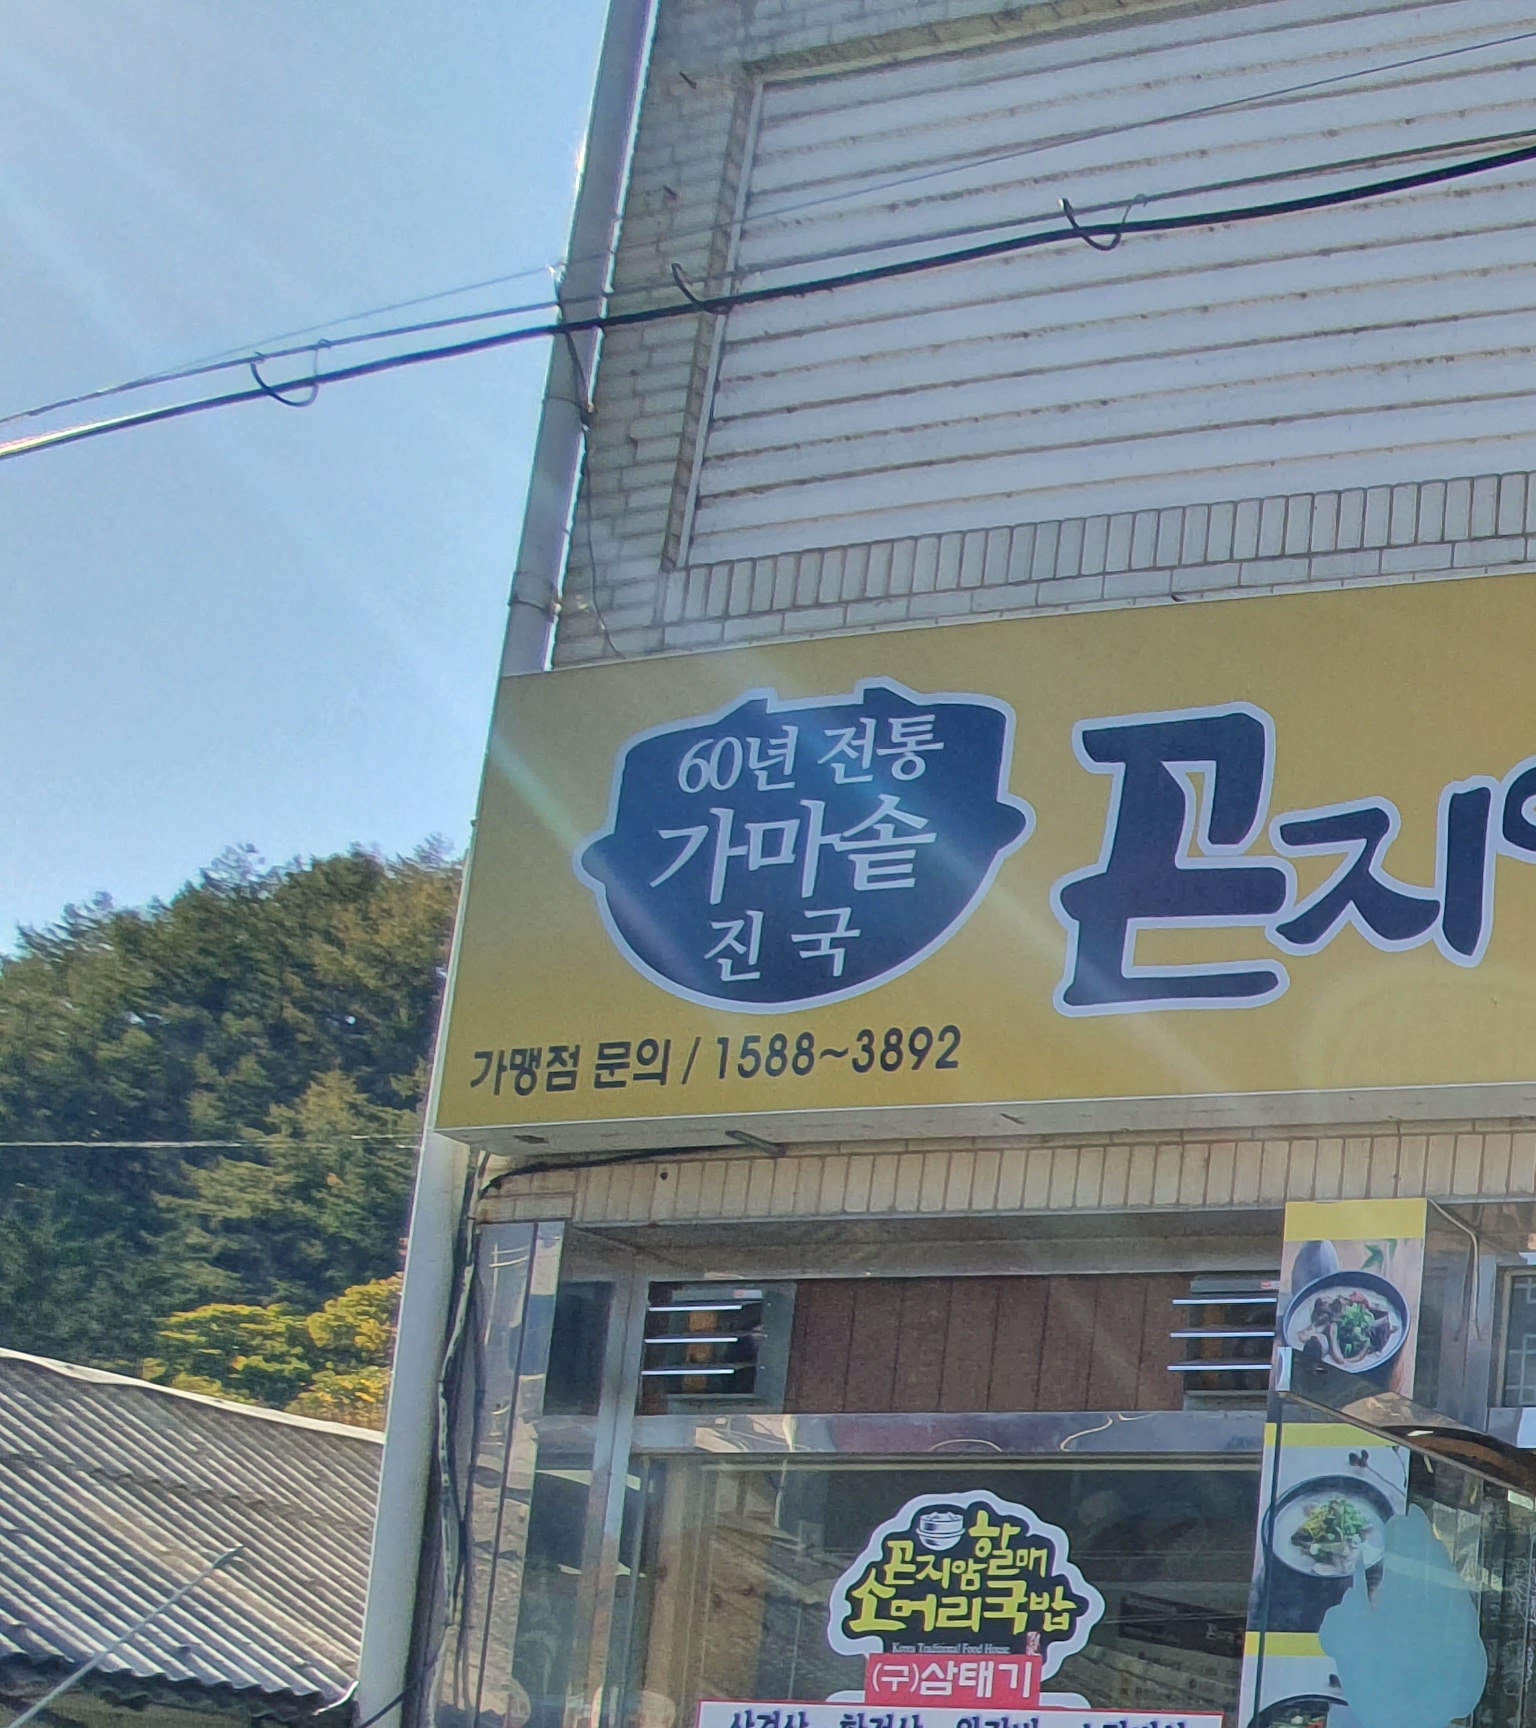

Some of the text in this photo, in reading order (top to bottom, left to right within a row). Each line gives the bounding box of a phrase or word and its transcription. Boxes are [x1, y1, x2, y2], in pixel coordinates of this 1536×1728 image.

[677, 712, 945, 794] 60년 전통
[650, 793, 938, 906] 가마솥
[470, 1042, 582, 1096] 가맹점
[592, 1036, 669, 1088] 문의
[714, 1024, 963, 1081] 1588~3892
[848, 1567, 1077, 1635] 소머리국밥
[884, 1540, 988, 1592] 곤지암
[871, 1660, 1033, 1699] (구)삼태기
